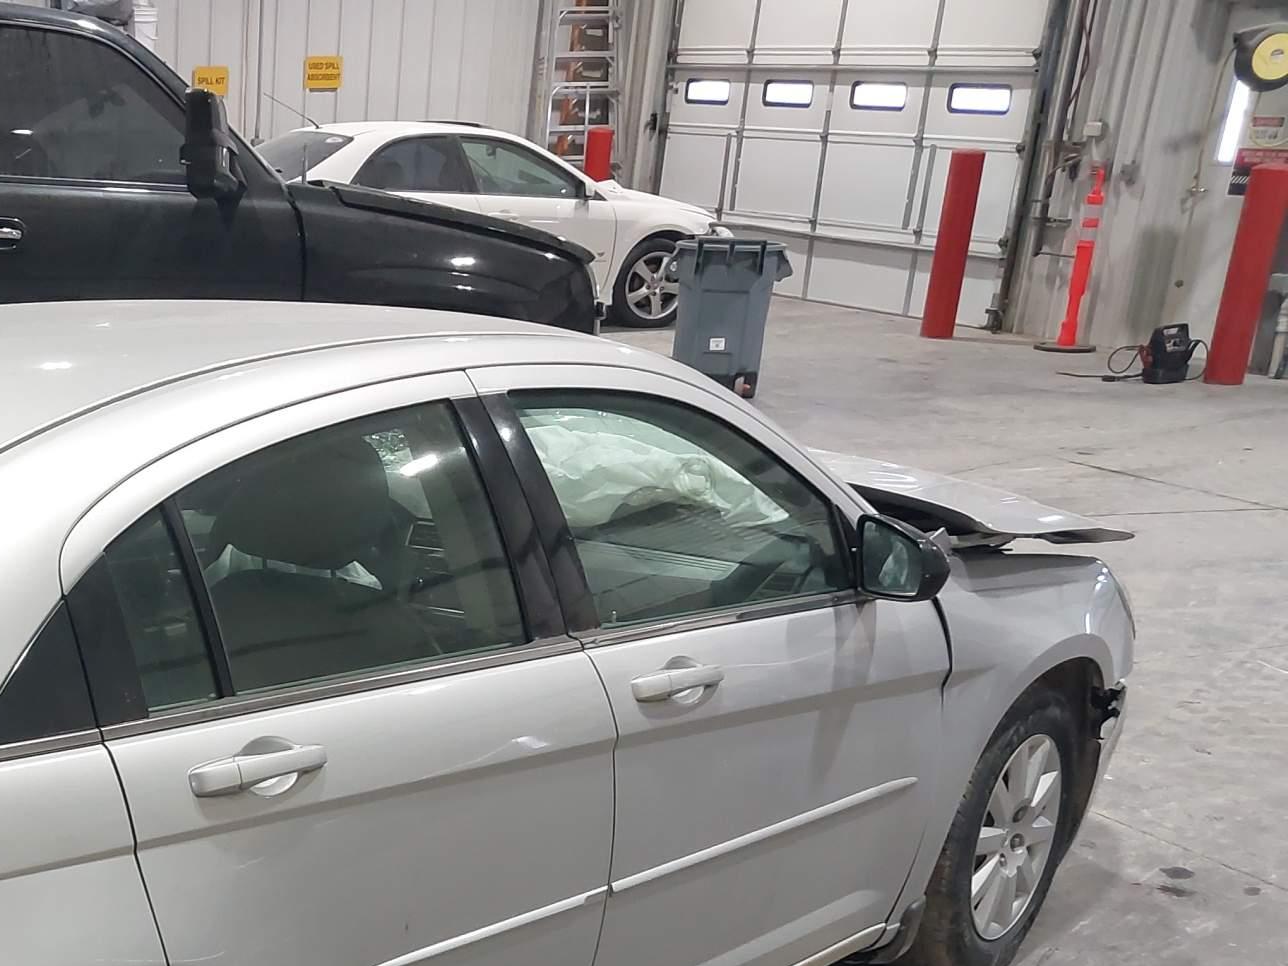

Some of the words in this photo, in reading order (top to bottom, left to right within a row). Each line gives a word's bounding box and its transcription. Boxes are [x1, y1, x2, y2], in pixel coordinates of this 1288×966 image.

[325, 62, 340, 70] SPILL
[197, 76, 214, 86] SPILL
[215, 76, 226, 86] KIT
